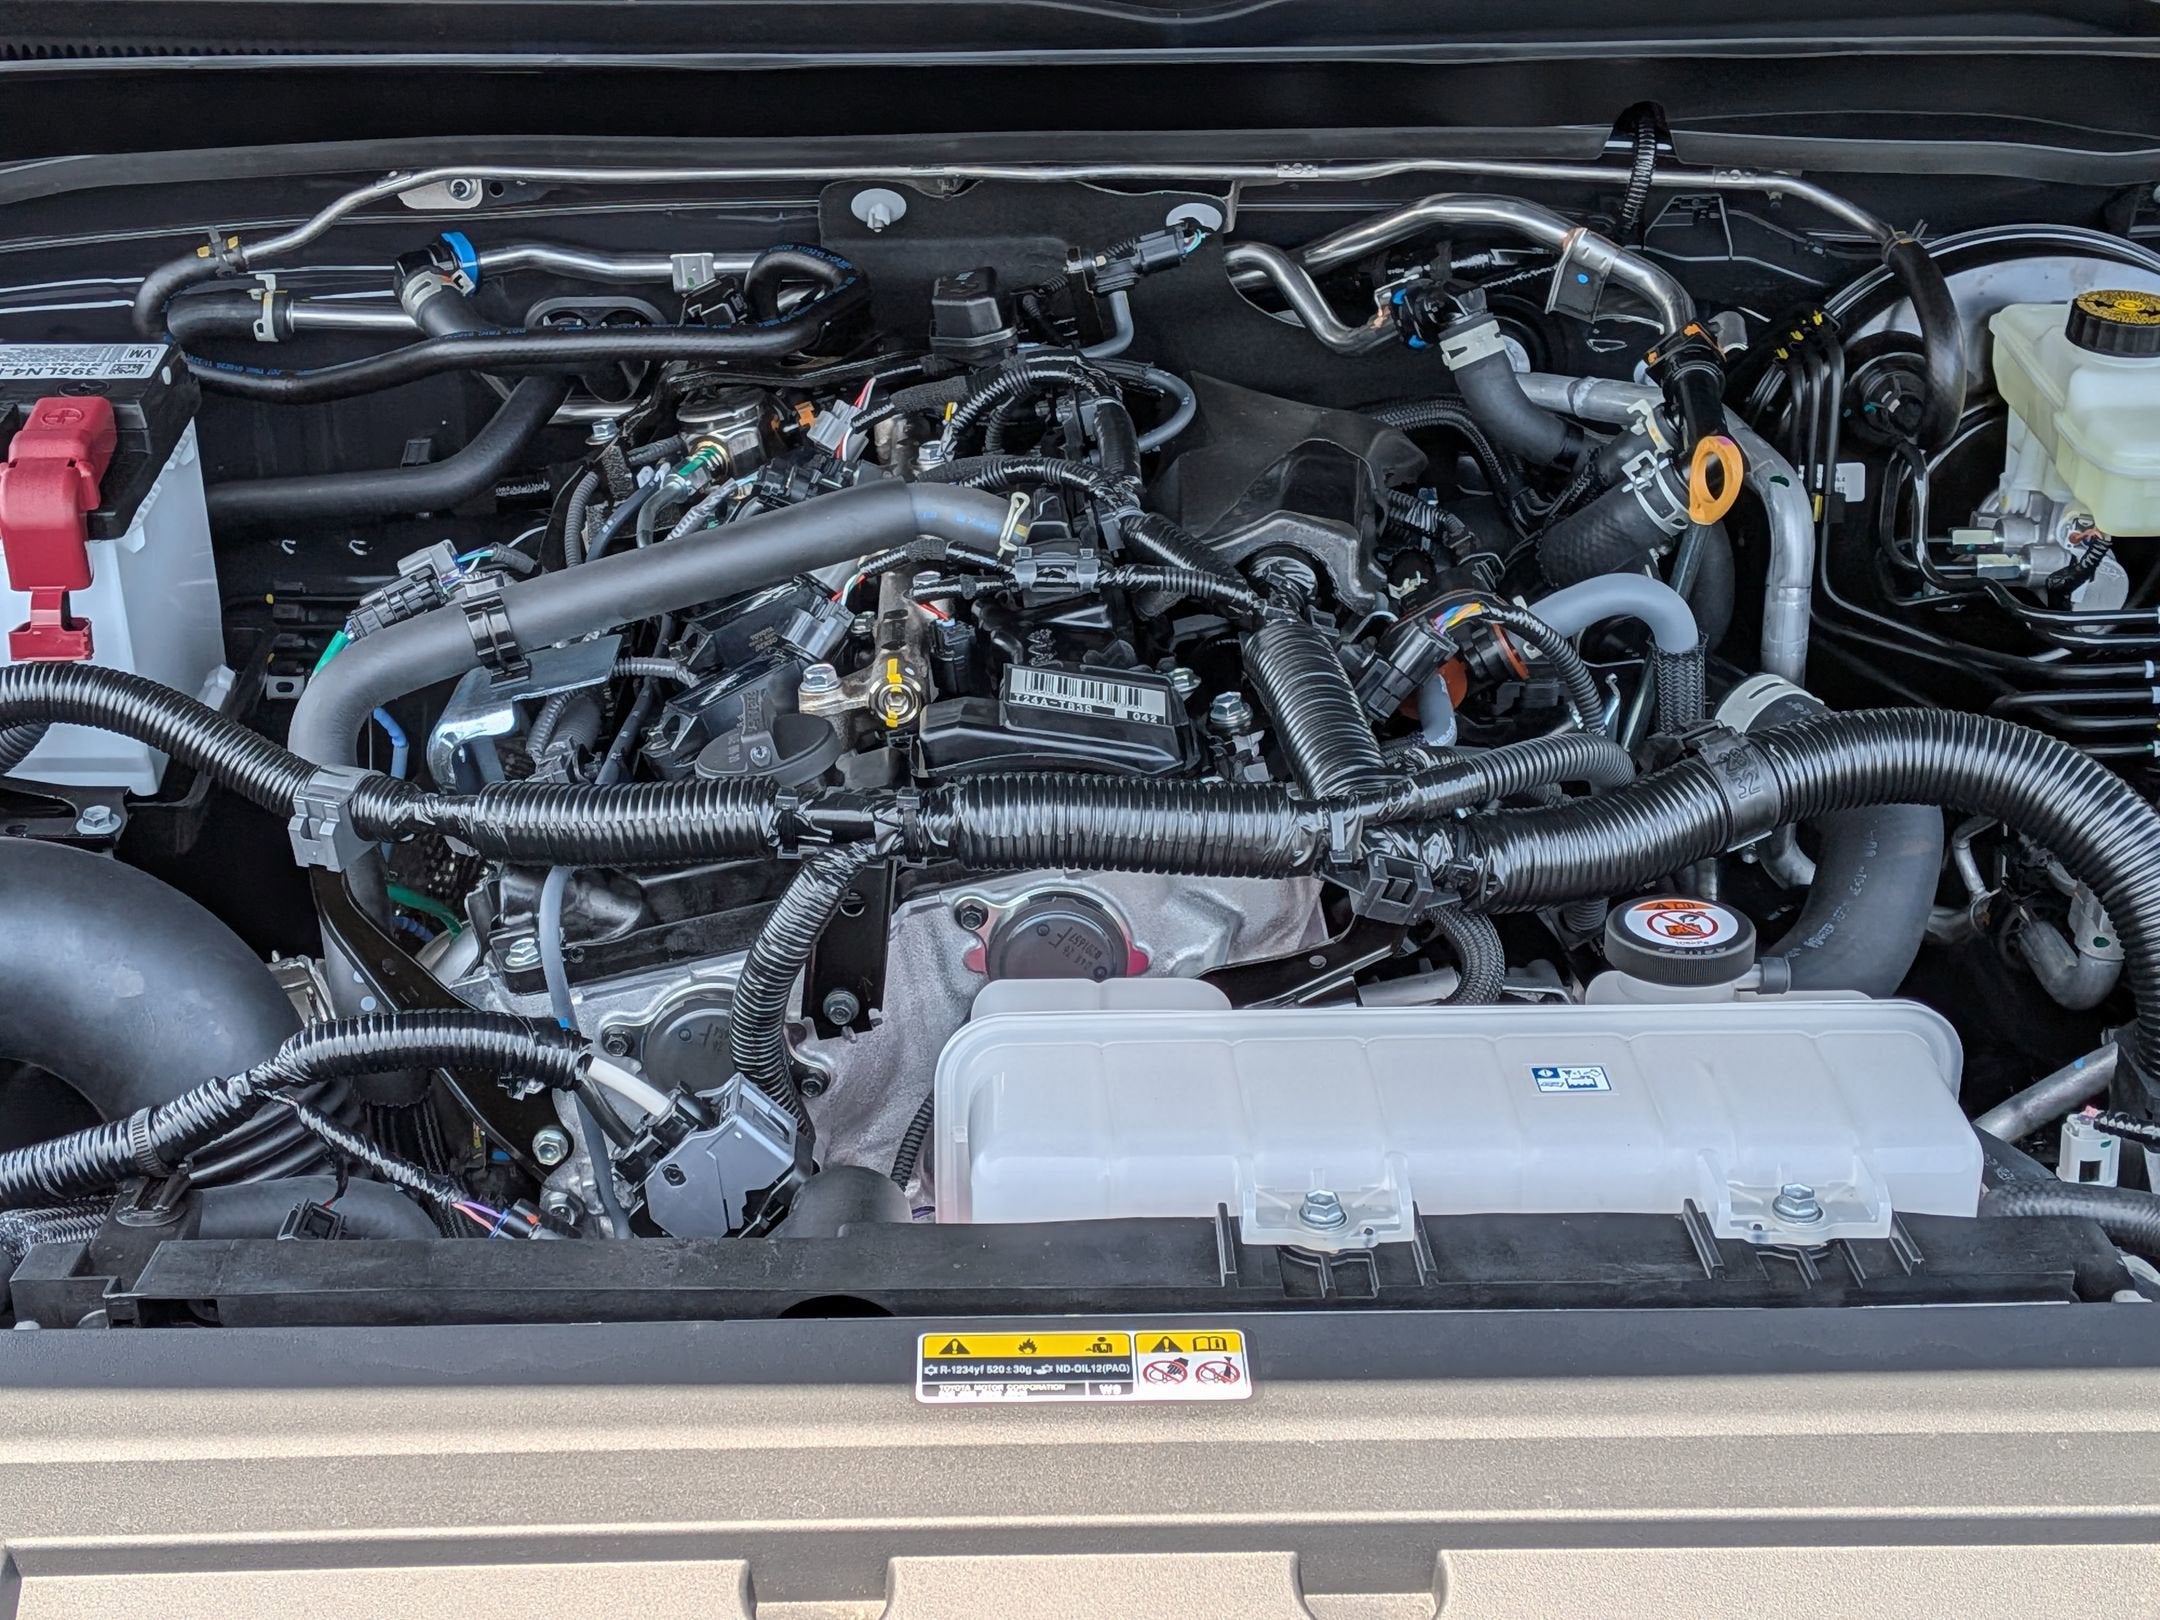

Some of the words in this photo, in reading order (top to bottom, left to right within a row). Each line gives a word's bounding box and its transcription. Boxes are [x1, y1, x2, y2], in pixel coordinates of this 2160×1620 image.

[128, 349, 152, 358] VM
[1132, 711, 1158, 724] 042
[940, 1364, 985, 1376] R-1234yf
[986, 1364, 1032, 1376] 520±30g
[1055, 1363, 1130, 1374] ND-OIL12(PAG)
[1006, 1384, 1066, 1392] CORPORATION
